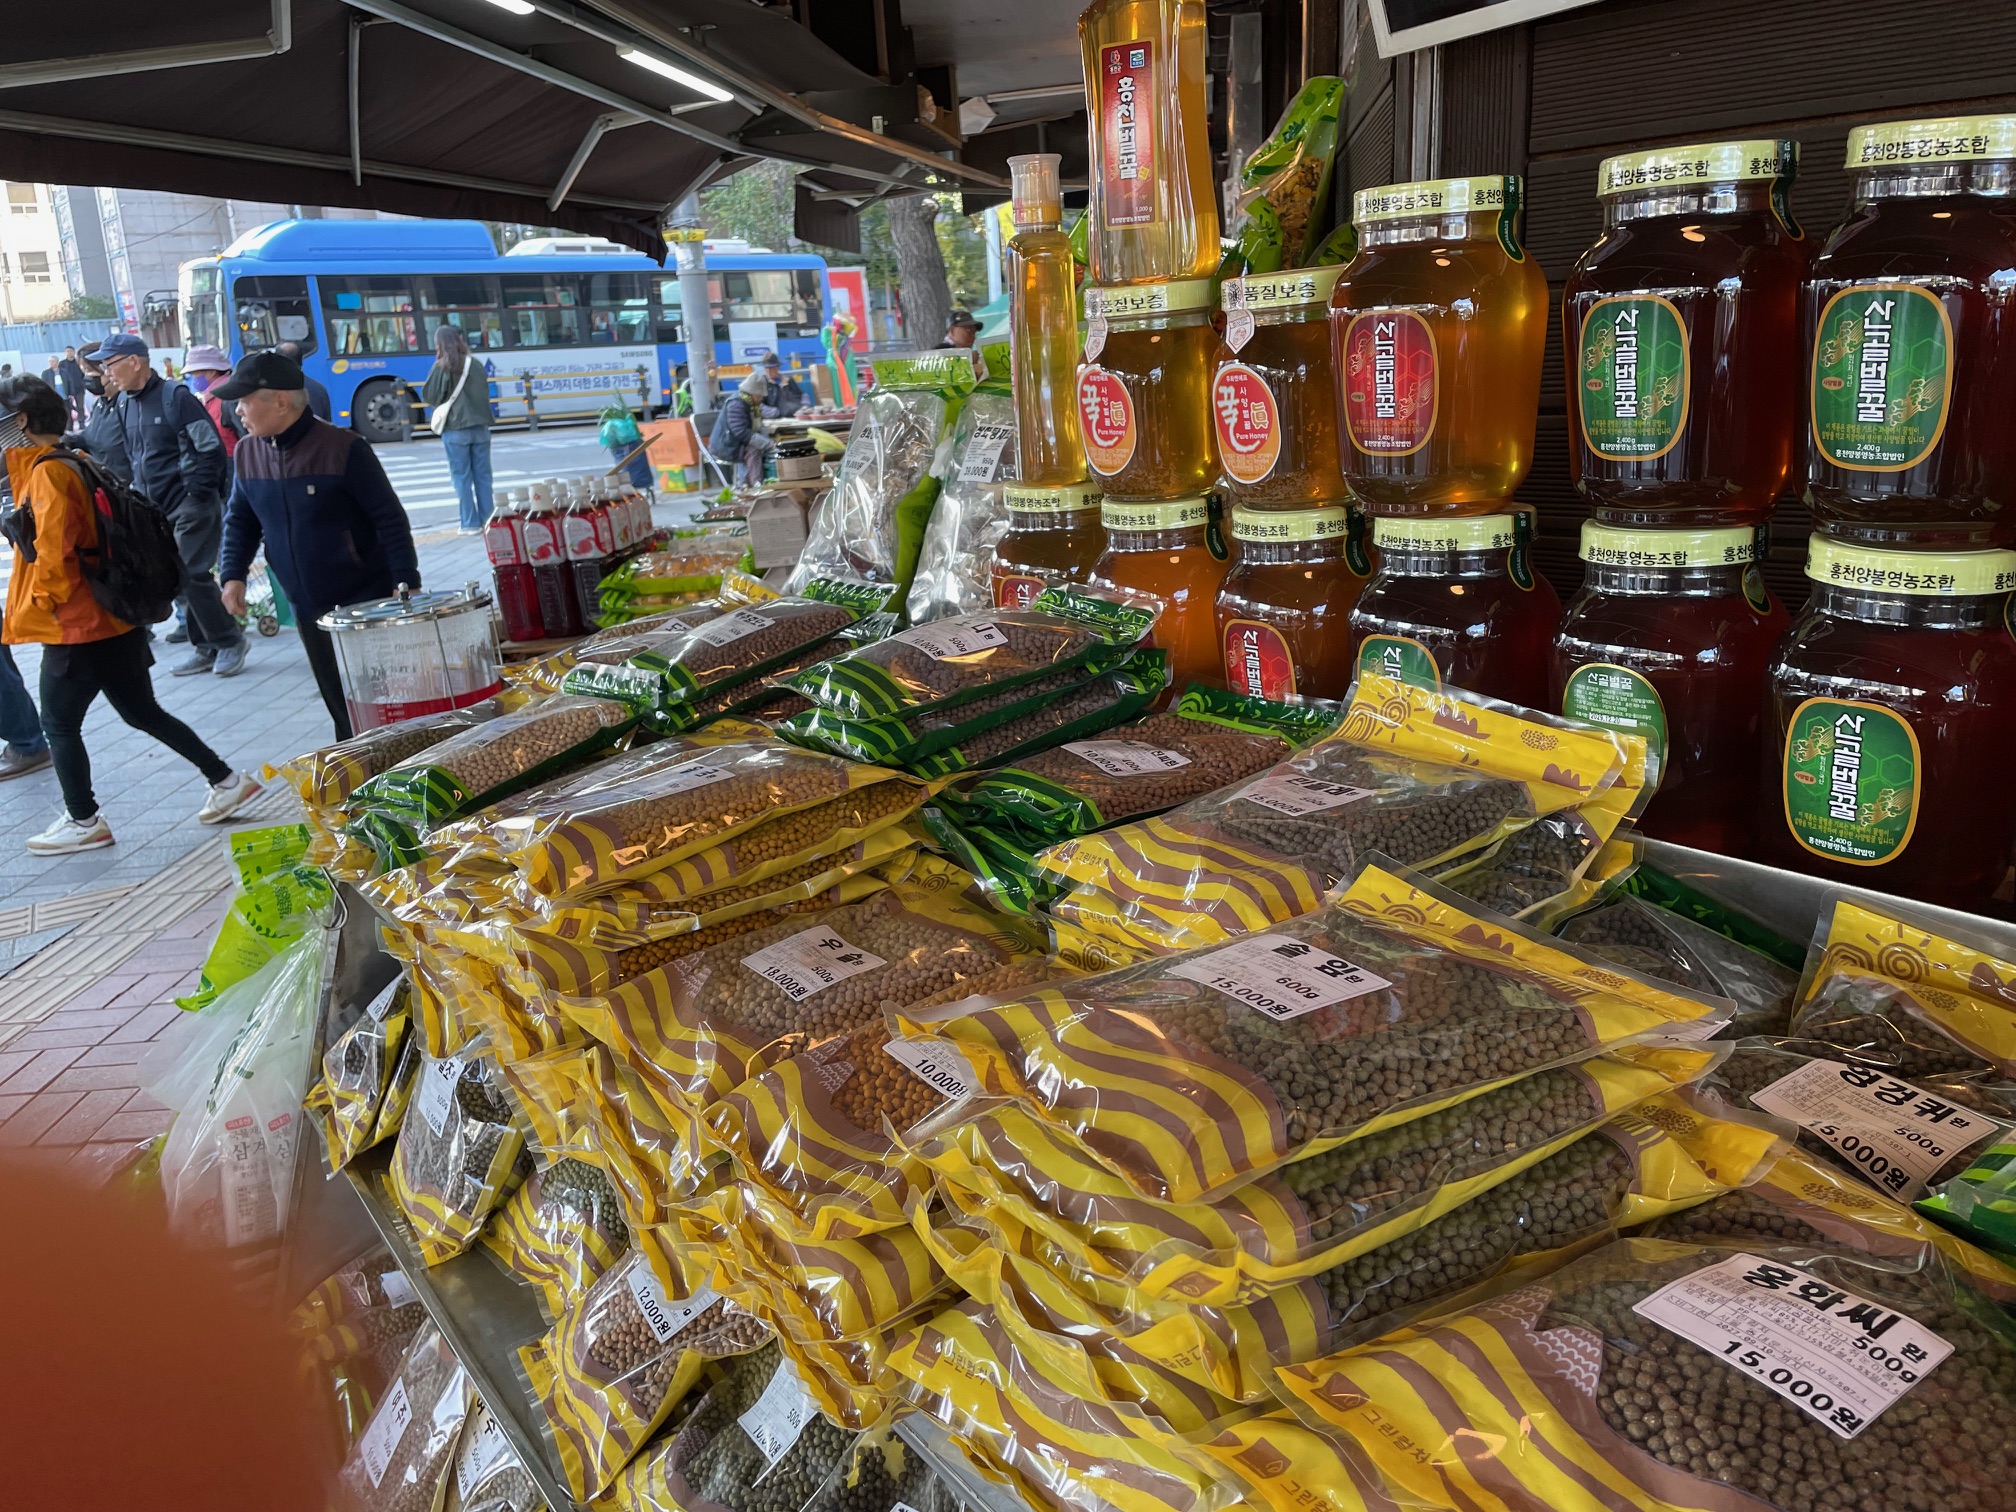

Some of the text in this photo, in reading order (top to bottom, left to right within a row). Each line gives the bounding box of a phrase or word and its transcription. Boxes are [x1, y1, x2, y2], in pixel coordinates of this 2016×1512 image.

[1117, 76, 1138, 180] 홍천벌꿀
[1101, 294, 1163, 313] 품질보증
[1244, 281, 1317, 302] 품질보증
[1374, 321, 1396, 418] 산골벌꿀
[1614, 309, 1639, 418] 산골벌꿀
[1857, 300, 1895, 422] 산골벌꿀
[515, 378, 572, 394] 블패스까지
[1081, 384, 1119, 447] 꿀
[1217, 385, 1260, 452] 꿀
[1098, 428, 1126, 437] Pure Honey
[1236, 432, 1268, 440] Pure Honey
[1103, 513, 1156, 526] 천양봉영농조합
[1233, 520, 1290, 537] 천양봉영농조합
[1587, 546, 1688, 566] 홍천양봉영농조합
[1830, 562, 1955, 591] 홍천양봉영농조합
[1588, 672, 1633, 690] 산골벌꿀
[1829, 713, 1866, 822] 산골벌꿀
[818, 938, 844, 951] 우
[1271, 943, 1312, 959] 솔
[762, 965, 809, 998] 18,000원
[811, 965, 834, 983] 500g
[1276, 977, 1320, 999] 600g
[1209, 976, 1294, 1016] 15,000원
[1839, 1063, 1958, 1124] 엉겅퀴
[1808, 1119, 1911, 1193] 15,000원
[1894, 1125, 1945, 1158] 500g
[637, 1285, 672, 1336] 12,000원
[1742, 1264, 1902, 1340] 홍화씨
[1900, 1342, 1928, 1364] 환
[1852, 1335, 1918, 1384] 500g
[1722, 1339, 1863, 1433] 15,000원
